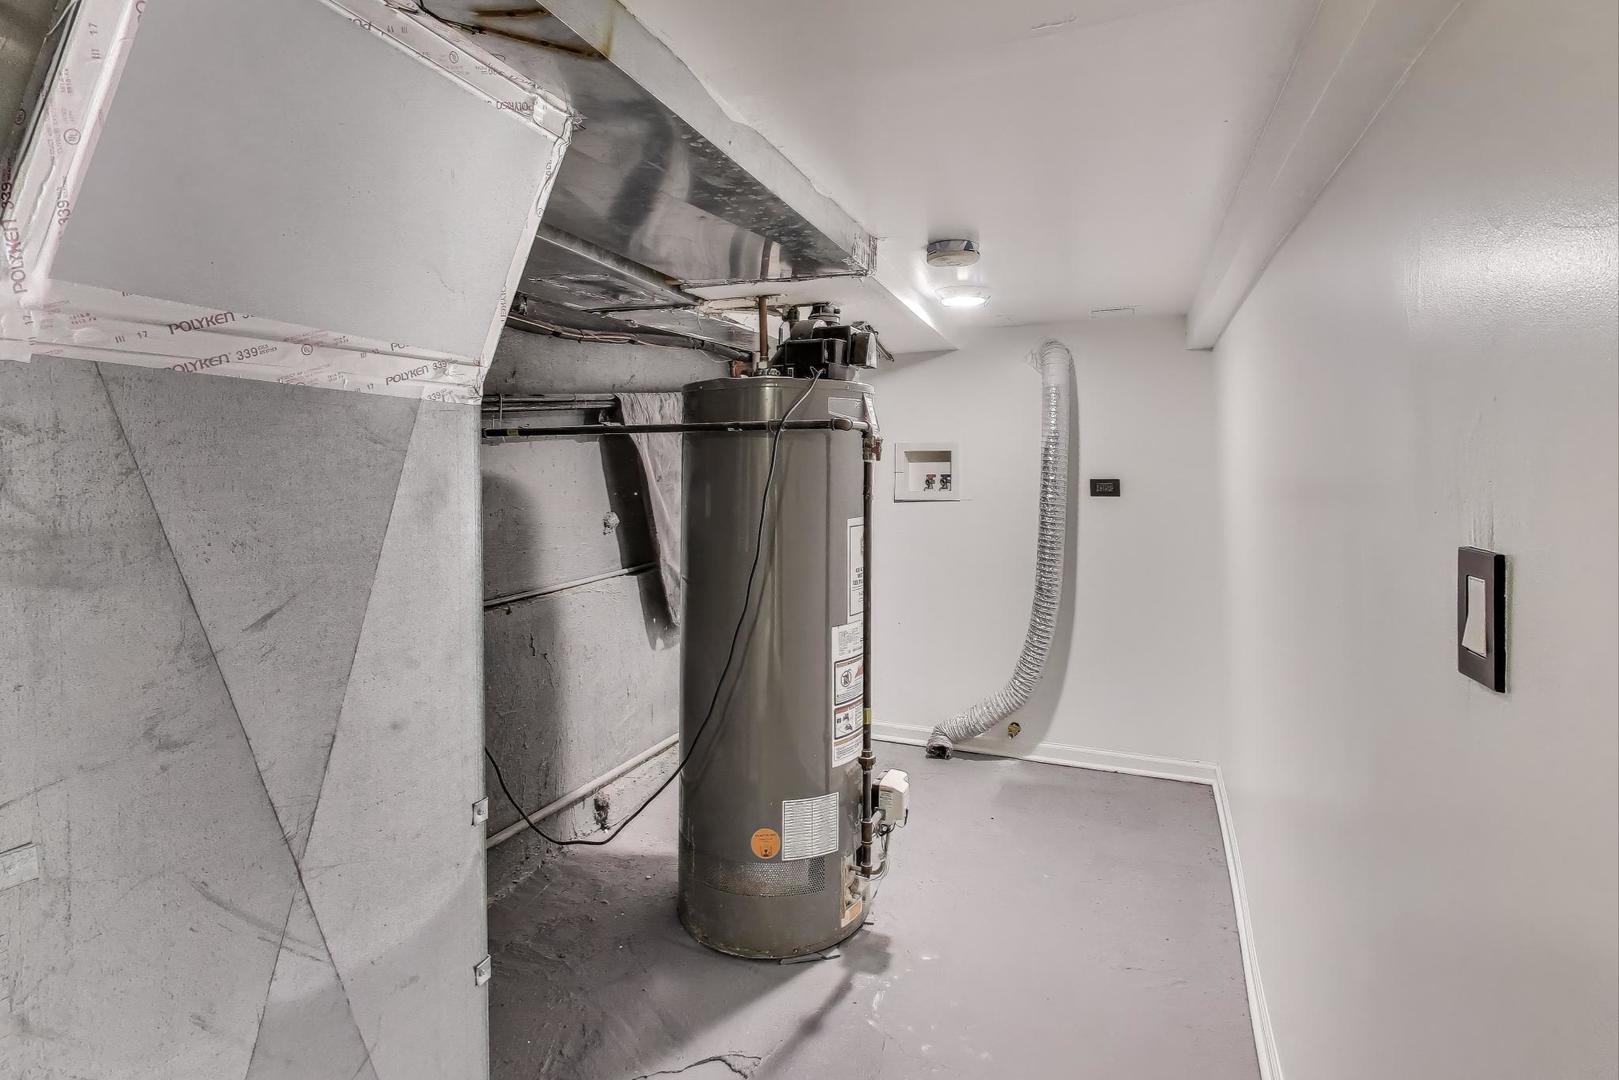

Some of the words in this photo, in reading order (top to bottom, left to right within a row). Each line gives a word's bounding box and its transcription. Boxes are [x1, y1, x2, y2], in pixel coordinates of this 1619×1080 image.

[2, 218, 28, 294] POLYKEN
[167, 311, 236, 335] POLYKEN
[237, 347, 259, 361] 339
[385, 365, 429, 386] POLYKEN
[432, 360, 448, 371] 339
